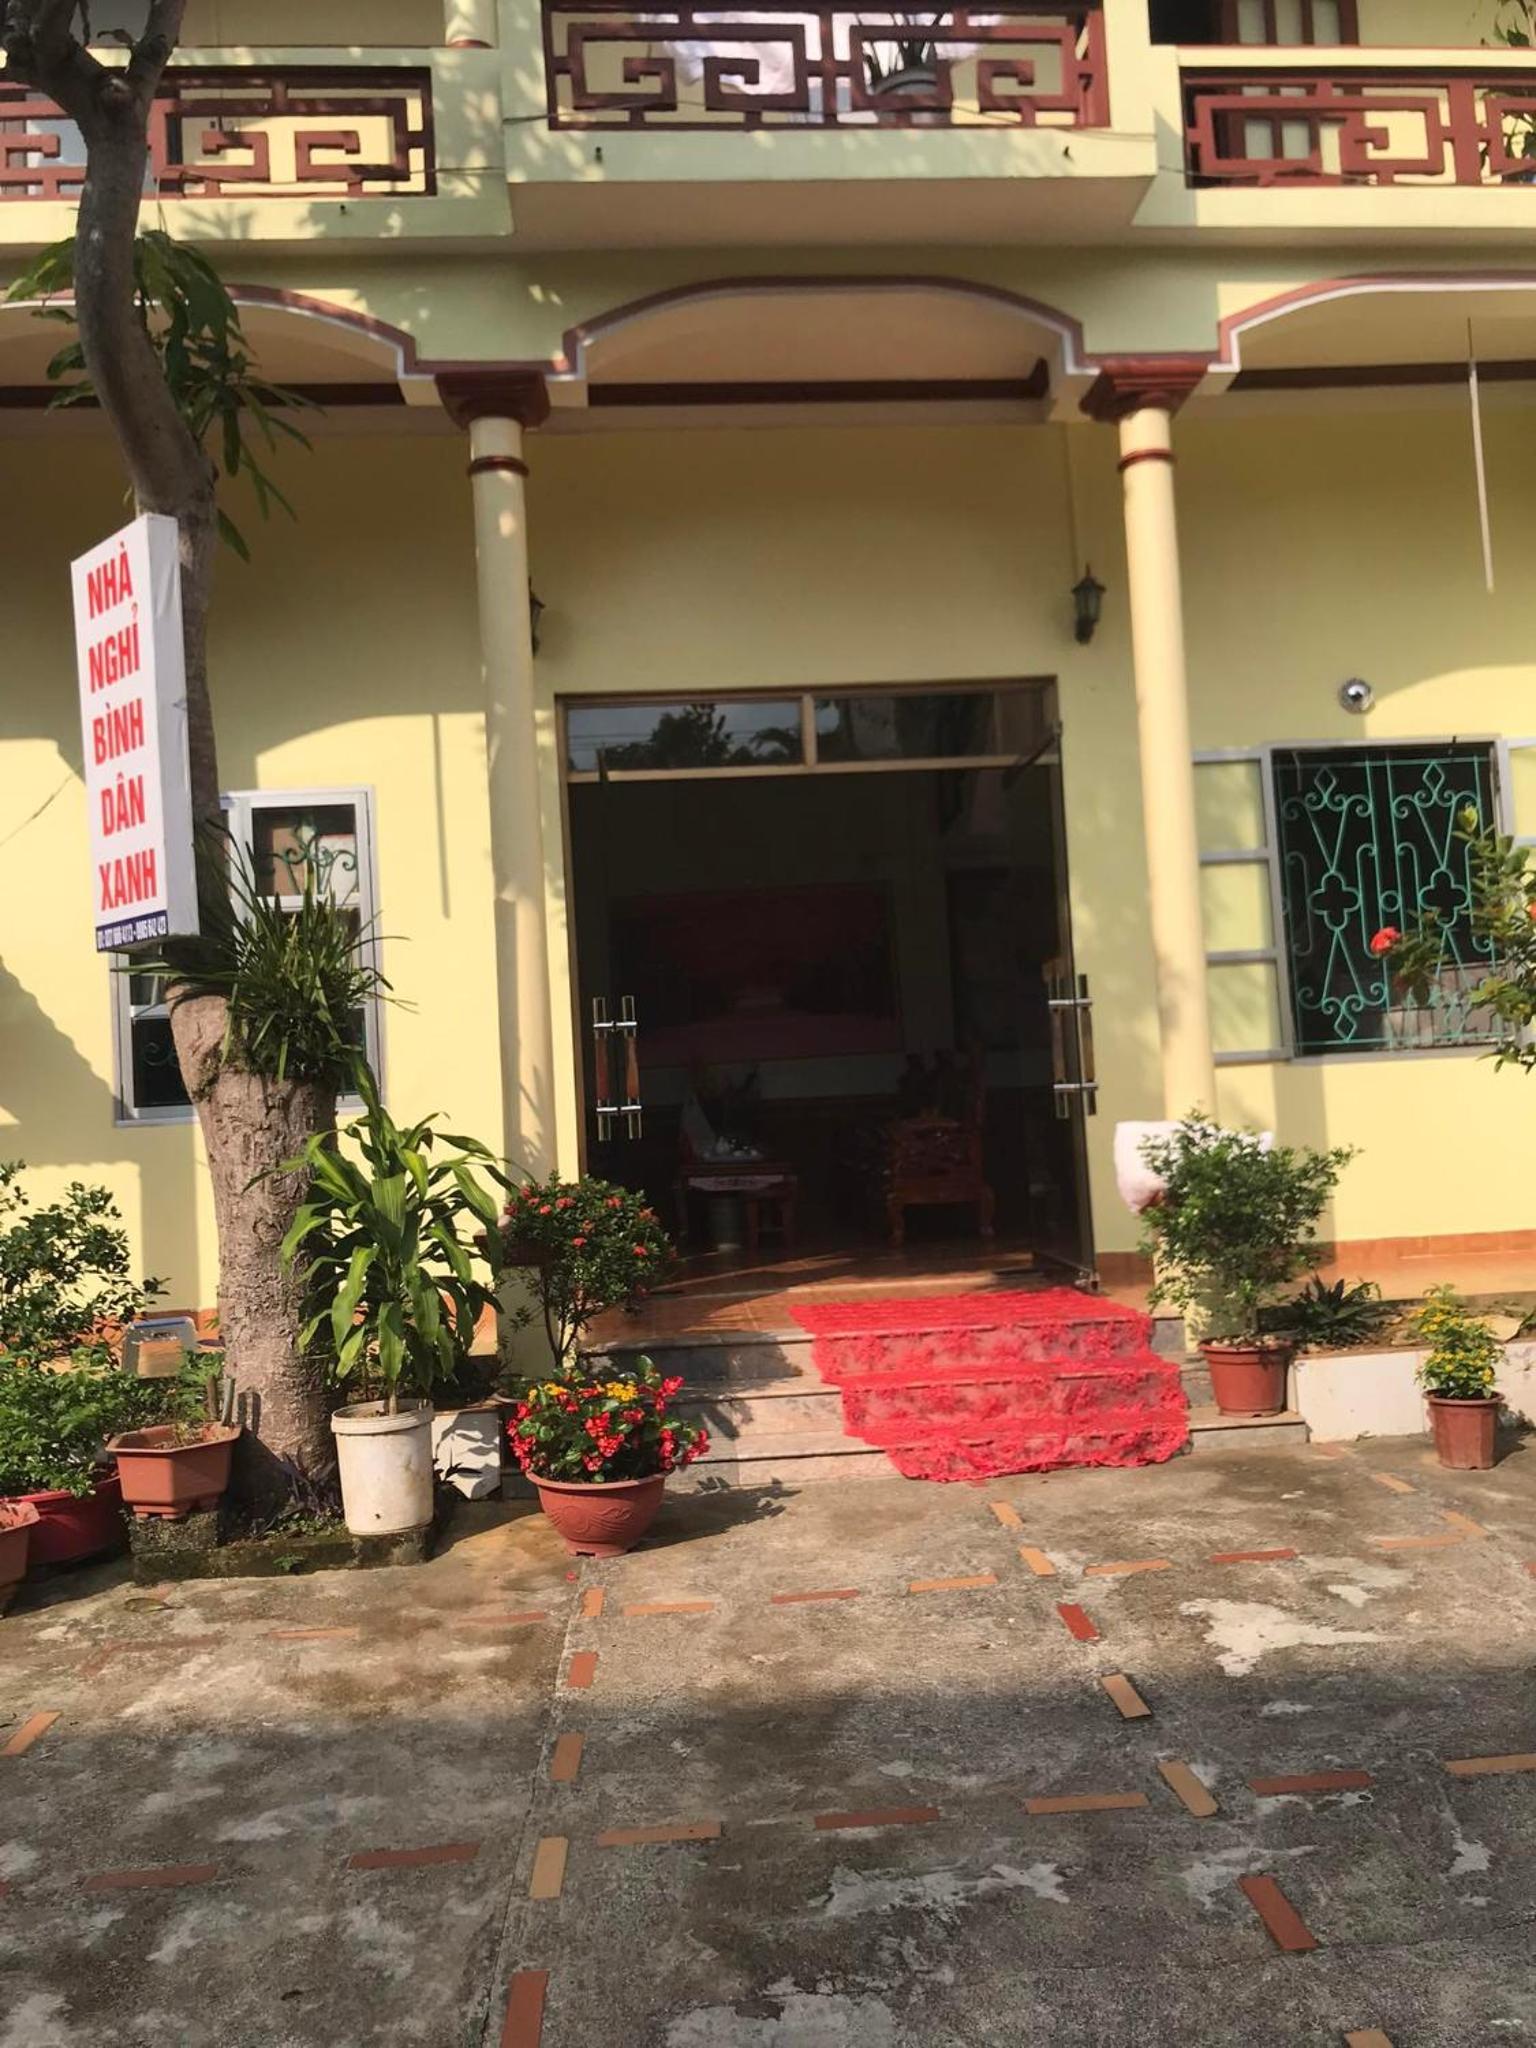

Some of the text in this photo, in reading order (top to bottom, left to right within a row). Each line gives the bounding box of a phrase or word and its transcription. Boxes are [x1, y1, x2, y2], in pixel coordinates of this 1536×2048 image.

[86, 540, 133, 620] NHÀ
[88, 602, 141, 694] NGHỈ
[91, 697, 146, 767] BÌNH
[99, 771, 147, 838] DÂN
[98, 848, 157, 912] XANH
